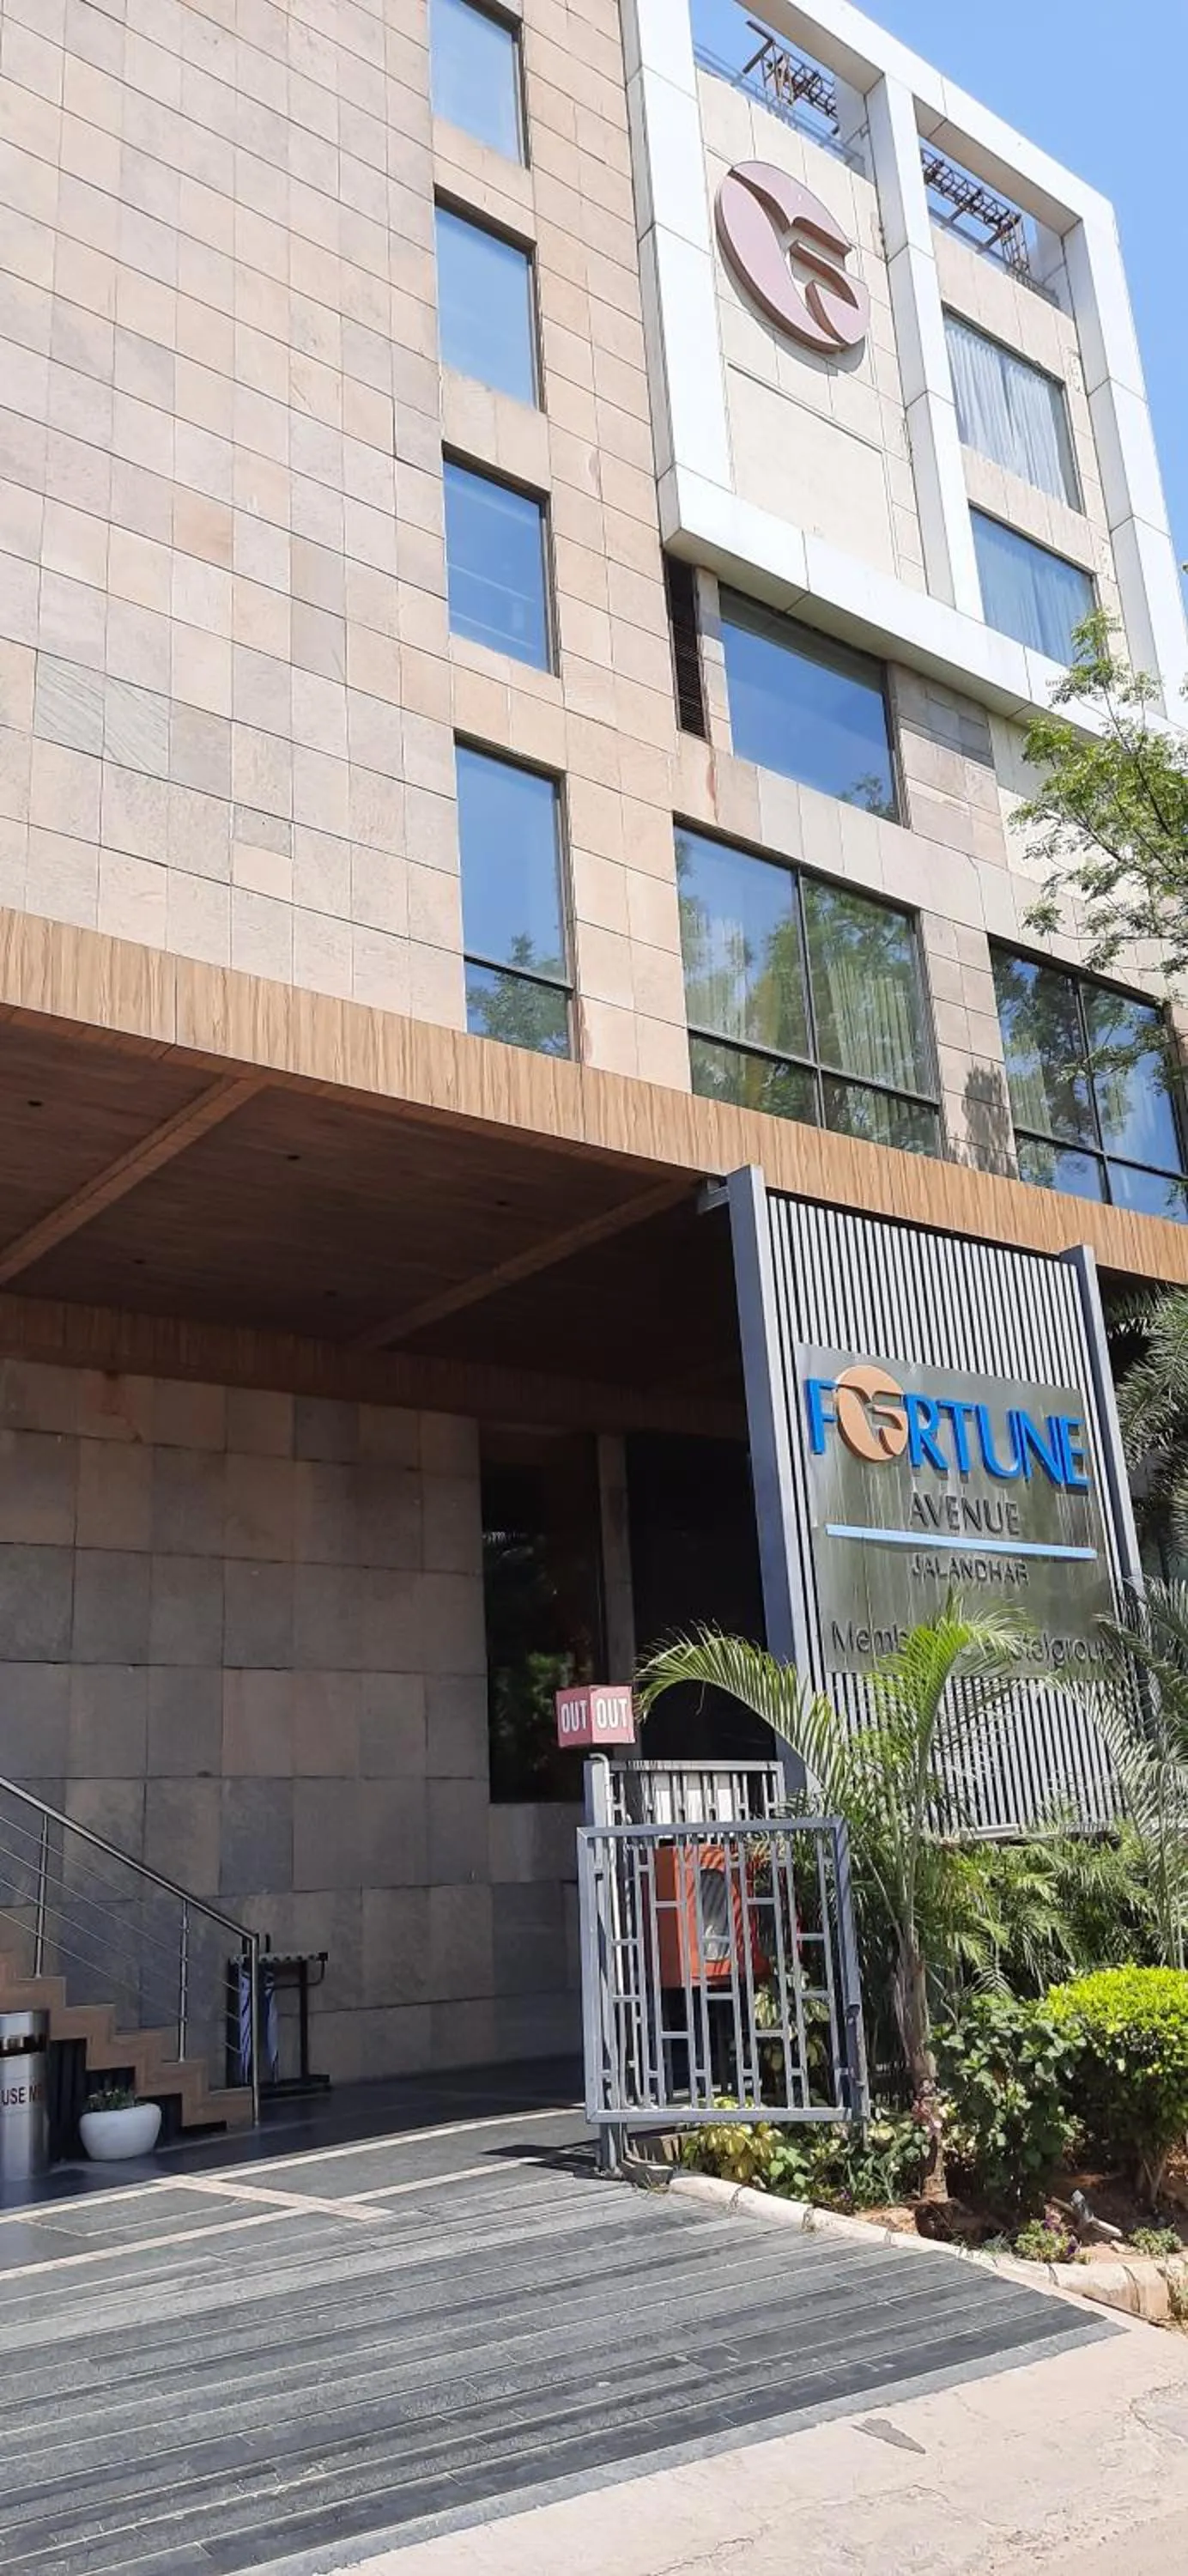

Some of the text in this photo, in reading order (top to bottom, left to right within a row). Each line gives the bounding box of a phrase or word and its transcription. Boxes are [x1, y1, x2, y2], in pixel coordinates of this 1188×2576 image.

[806, 1365, 1089, 1491] FORTUNE
[910, 1492, 1020, 1536] AVENUE
[911, 1553, 1029, 1587] JALANDHAR
[561, 1699, 587, 1734] OUT
[596, 1698, 627, 1729] OUT
[1, 2086, 26, 2106] USE
